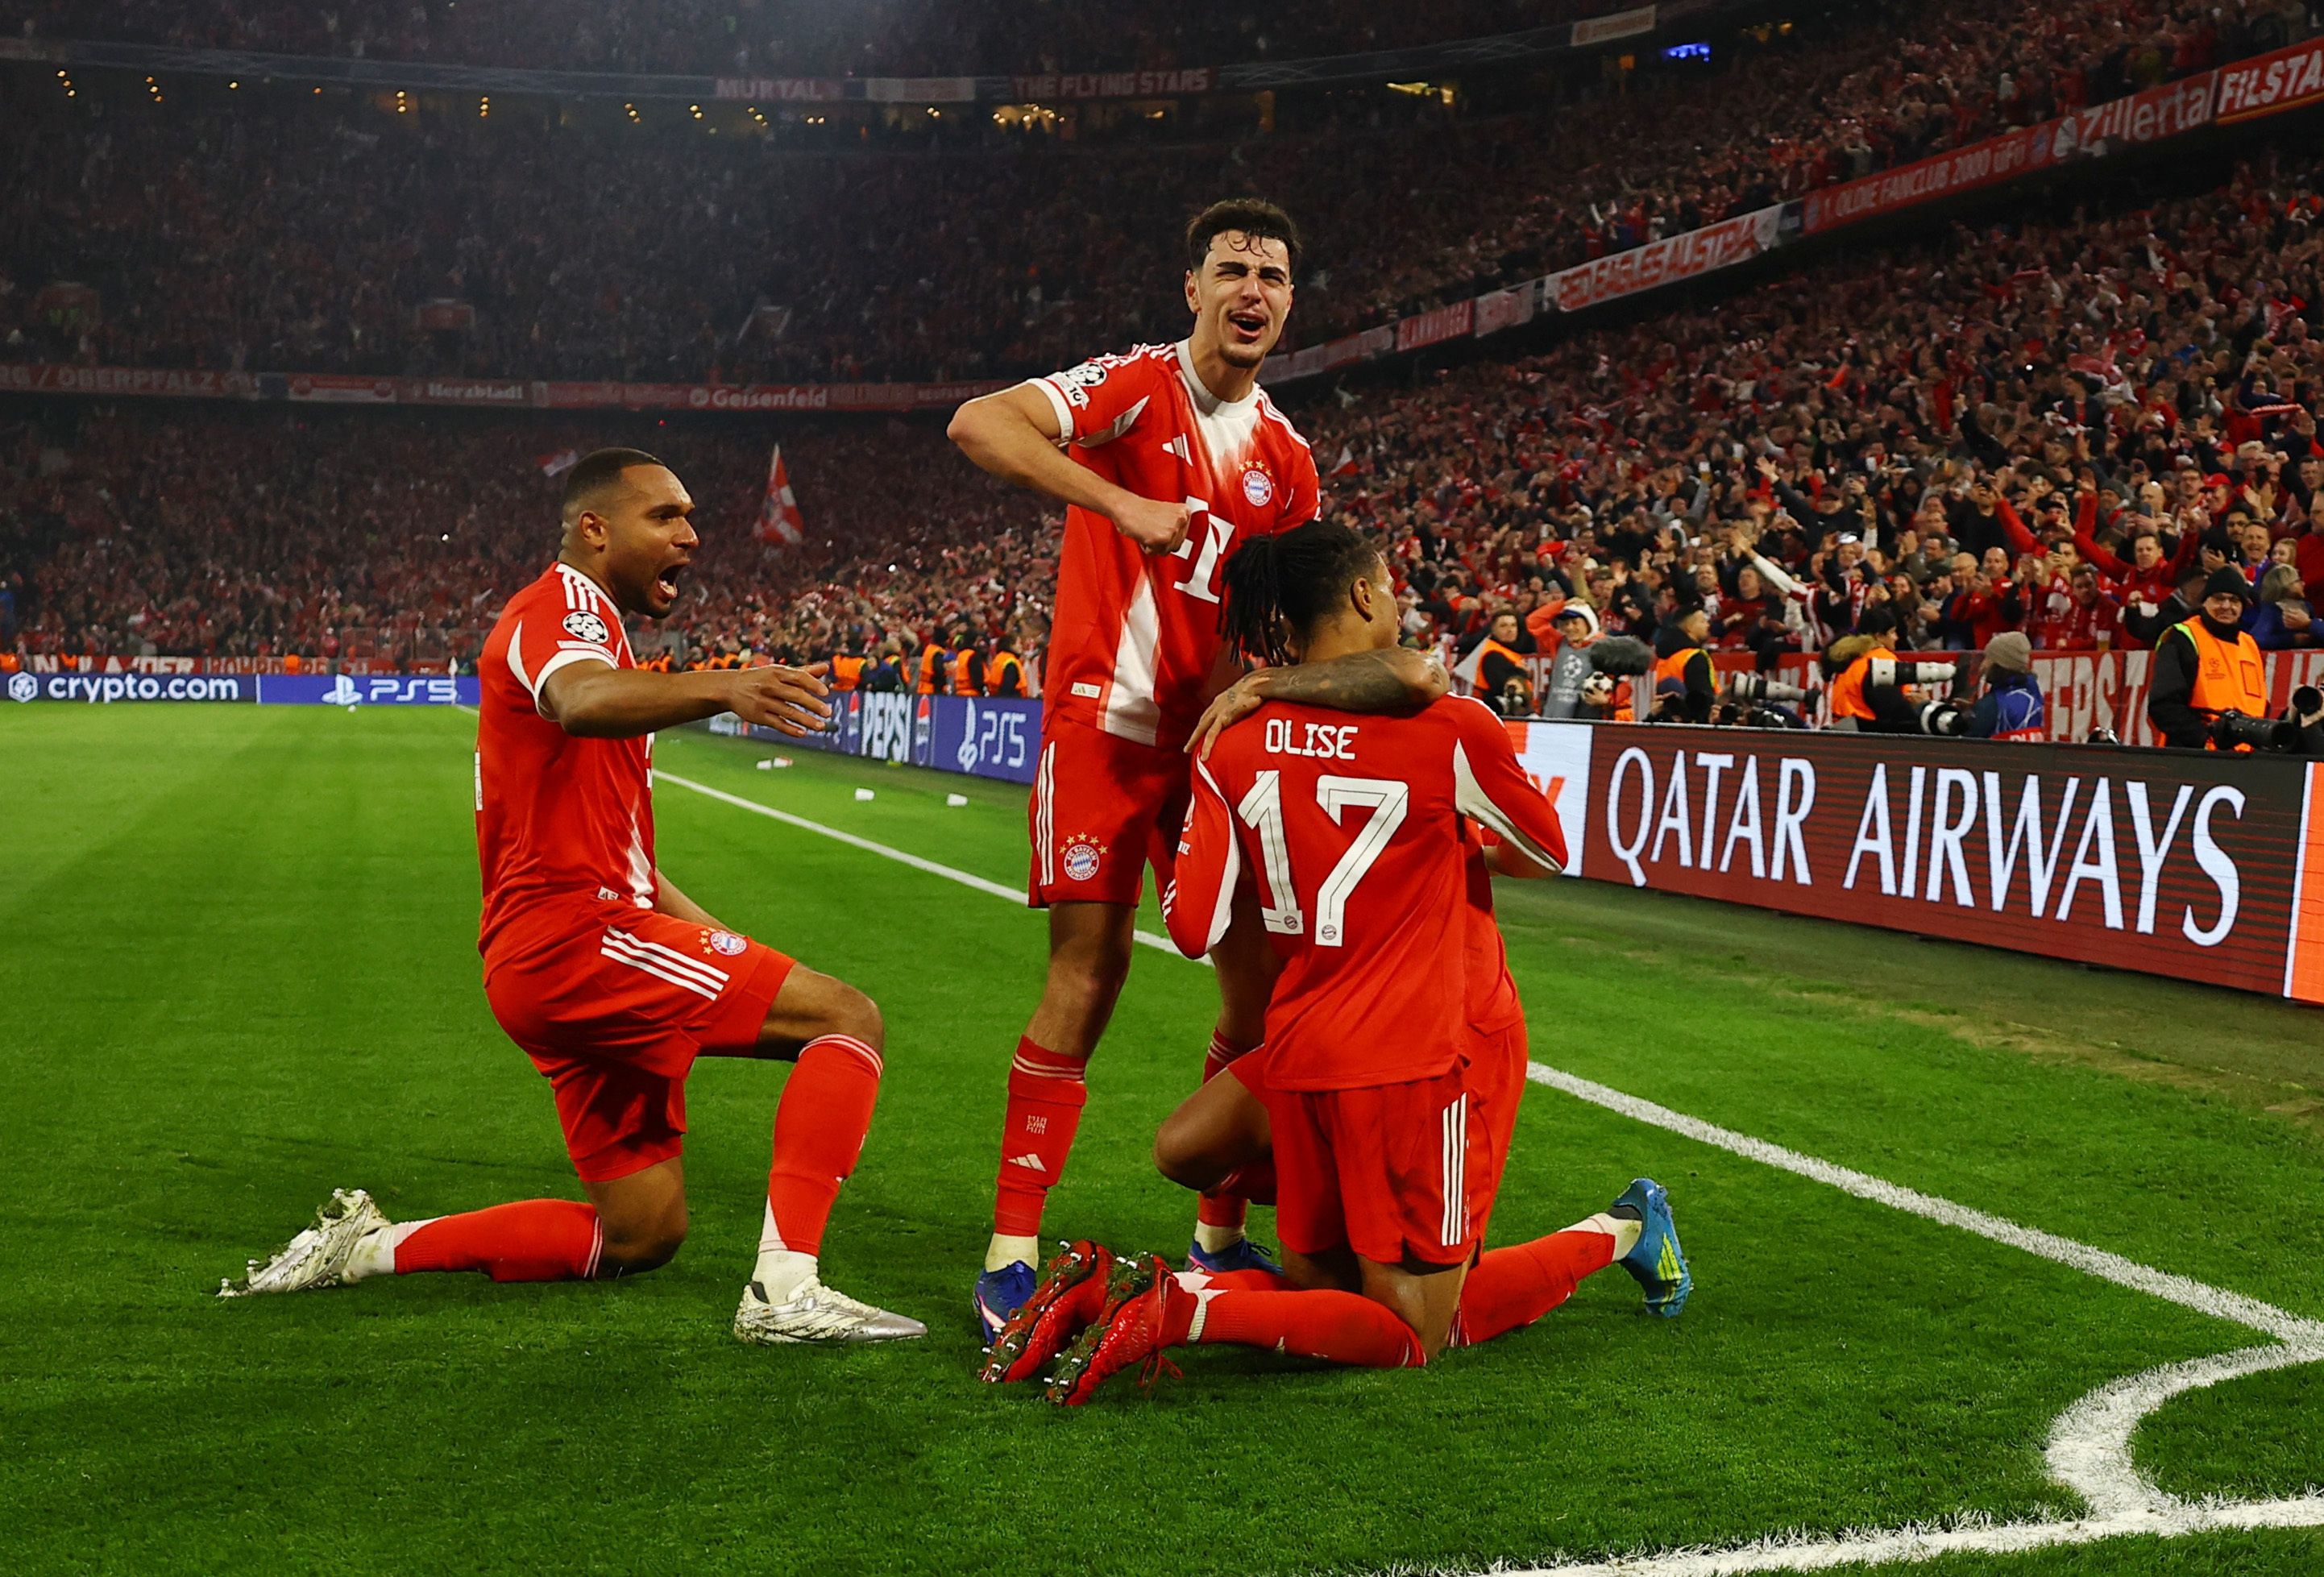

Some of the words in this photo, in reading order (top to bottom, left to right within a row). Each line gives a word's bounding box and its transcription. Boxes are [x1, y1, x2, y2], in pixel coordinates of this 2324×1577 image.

[1015, 77, 1056, 98] THE
[1060, 73, 1135, 97] FLYING
[1139, 68, 1209, 94] STARS
[2218, 49, 2324, 114] FILSTA
[2079, 68, 2218, 158] Zillertal
[1881, 160, 1950, 205] FANCLUB
[712, 388, 827, 408] Geisenfeld
[48, 674, 239, 703] crypto.com
[370, 679, 458, 702] PS5
[861, 691, 913, 762] PEPSI
[980, 710, 1027, 769] PS5
[1264, 718, 1359, 760] OLISE
[1073, 846, 1097, 861] BAYERN
[1238, 770, 1409, 947] 17
[1606, 746, 1816, 887] QATAR
[1843, 762, 2246, 947] AIRWAYS
